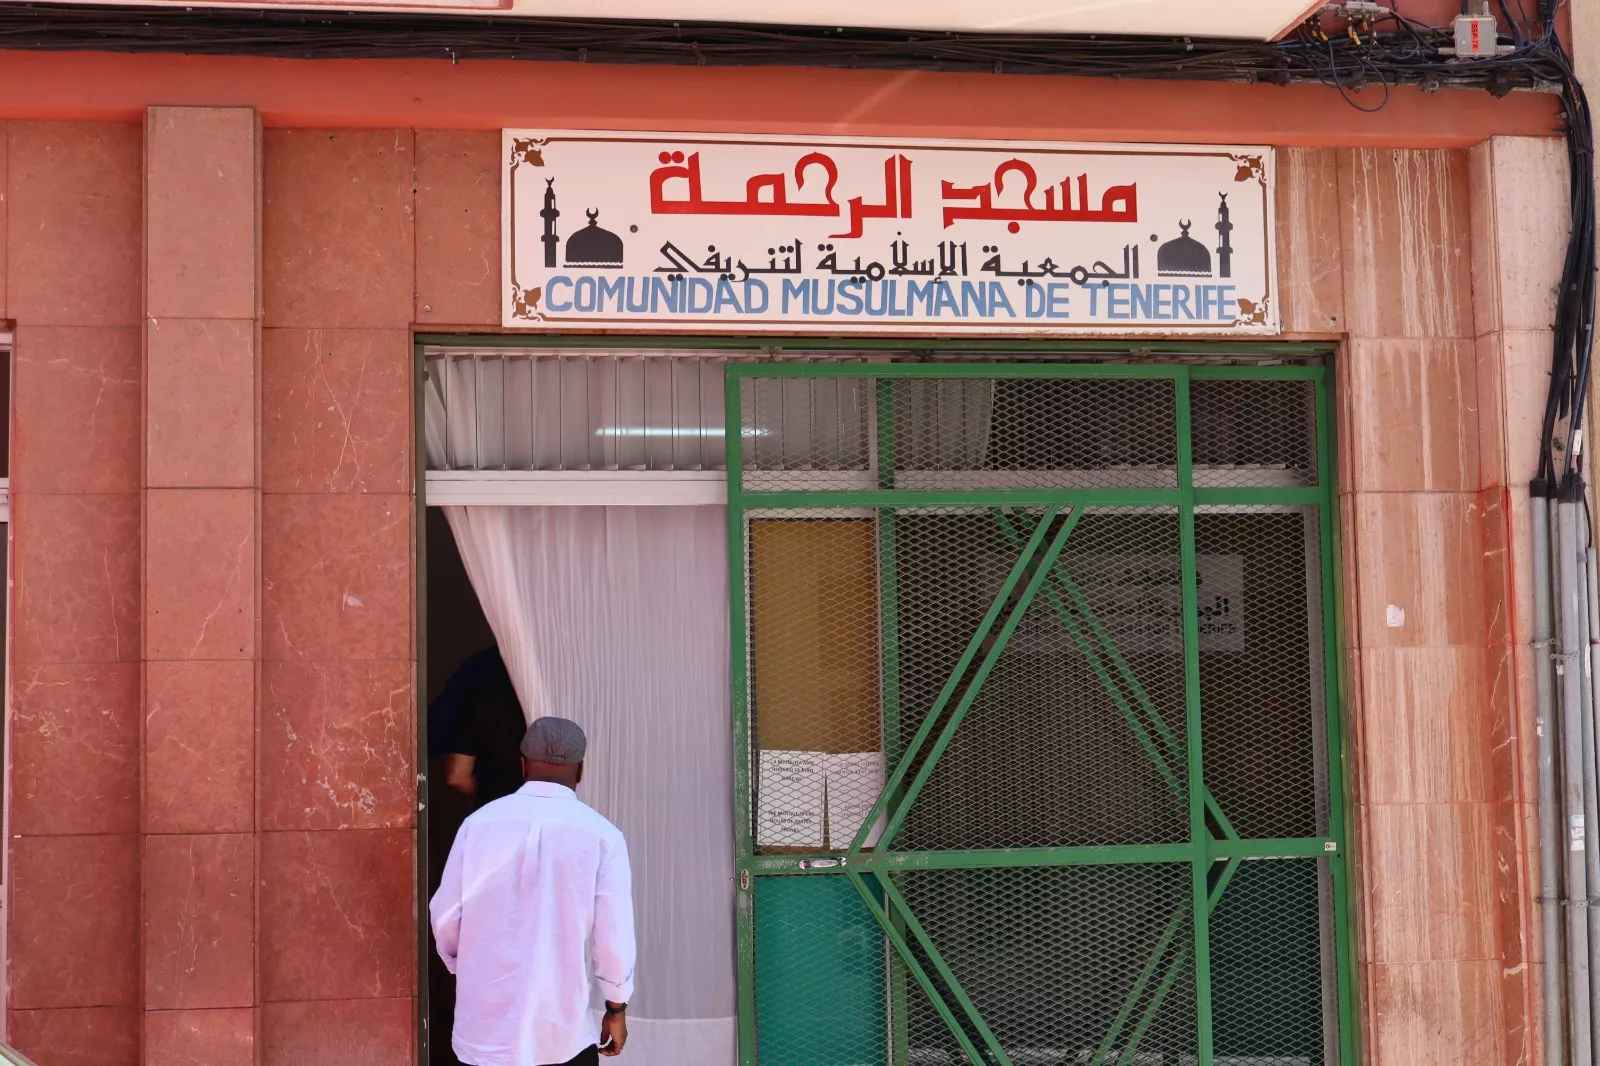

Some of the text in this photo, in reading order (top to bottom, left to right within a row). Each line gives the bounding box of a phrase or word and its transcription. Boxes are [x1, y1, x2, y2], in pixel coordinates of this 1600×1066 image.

[649, 151, 1137, 239] مسجد الرحمة
[980, 243, 1139, 288] الجمعية
[546, 275, 1236, 321] COMUNIDAD MUSULMANA DE TENERIFE
